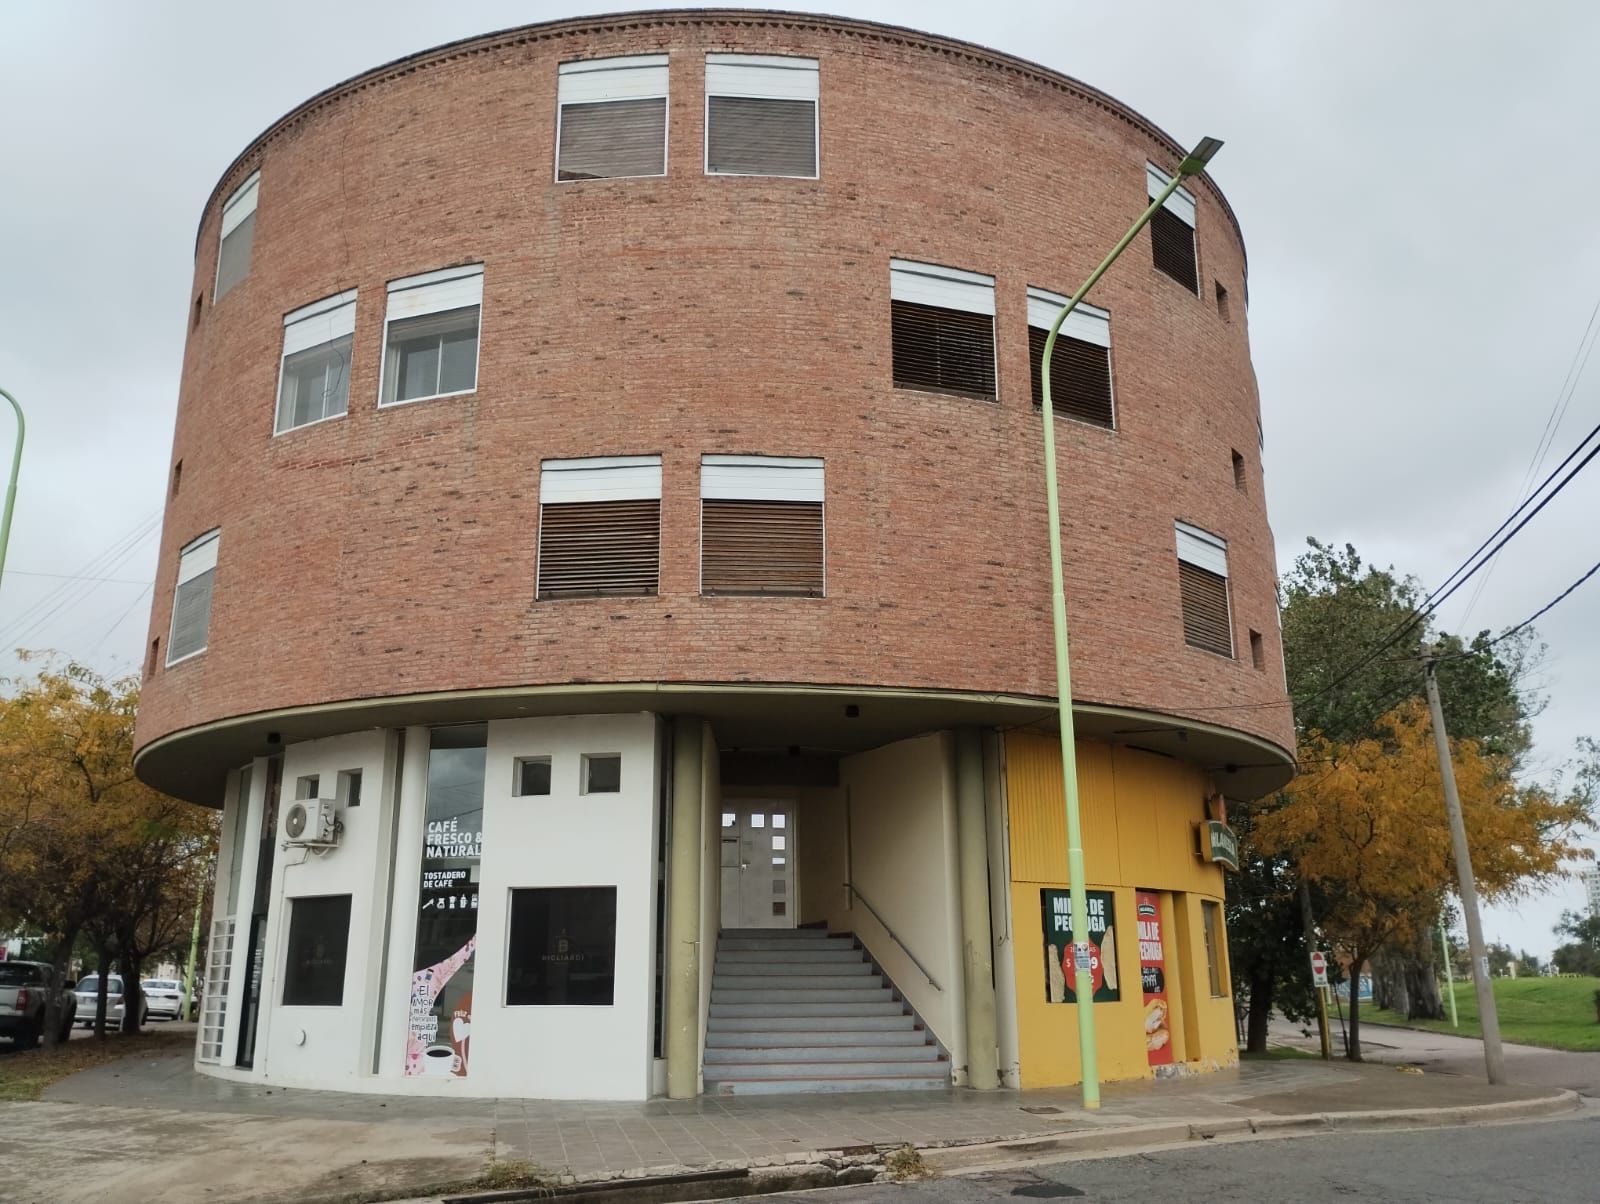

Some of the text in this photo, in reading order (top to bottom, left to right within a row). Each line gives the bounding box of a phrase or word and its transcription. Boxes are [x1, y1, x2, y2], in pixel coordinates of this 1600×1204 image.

[428, 817, 458, 833] CAFÉ
[426, 831, 482, 846] FRESCO &
[426, 844, 482, 858] NATURAL
[423, 871, 466, 880] TOSTADERO
[423, 880, 433, 888] DE
[1089, 898, 1105, 915] DE
[1054, 915, 1106, 932] PEGA
